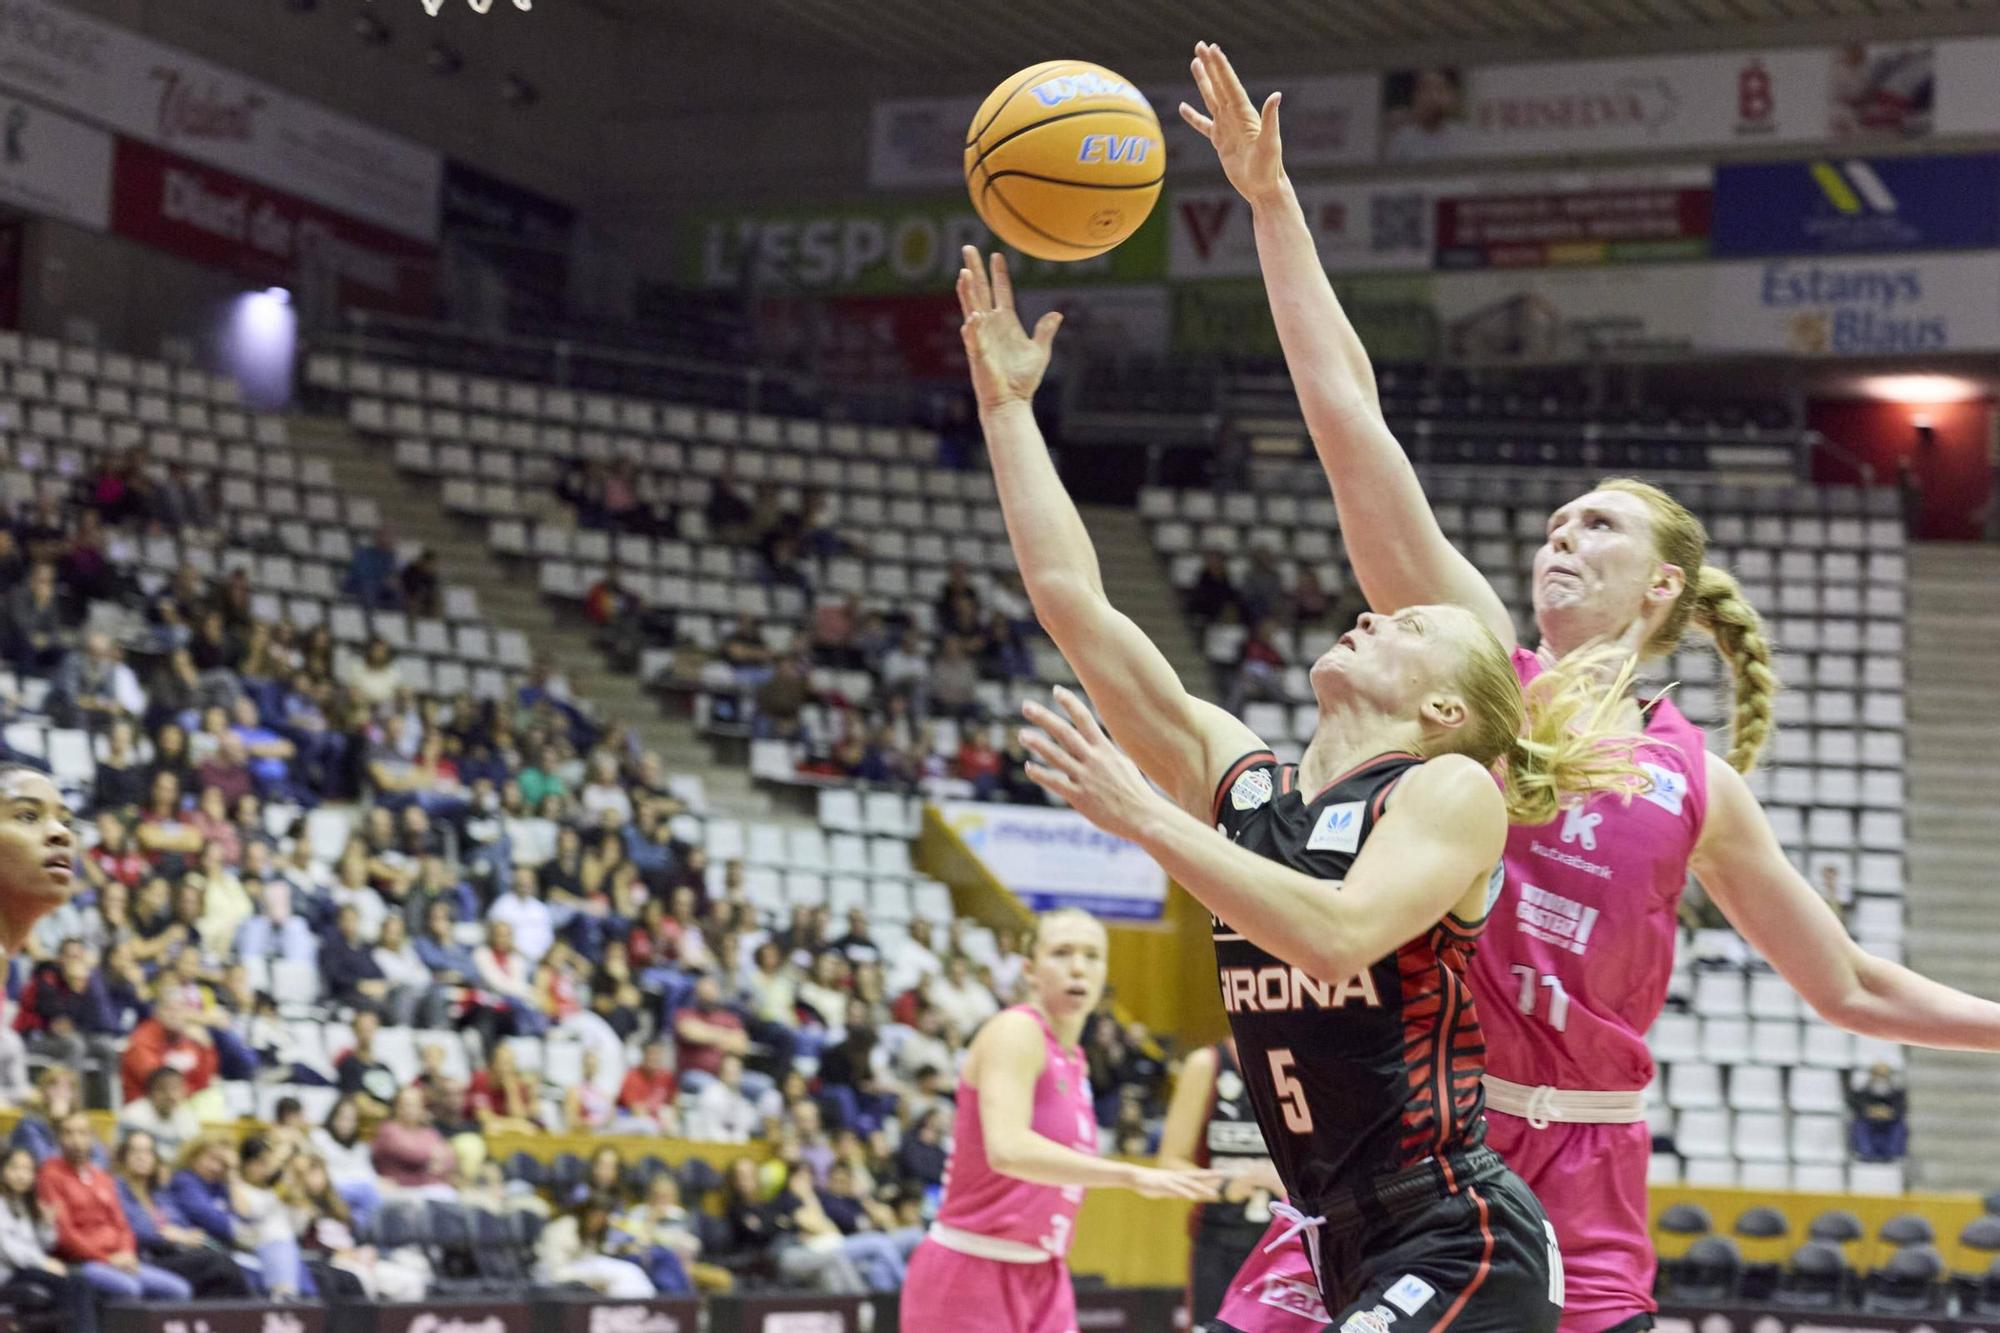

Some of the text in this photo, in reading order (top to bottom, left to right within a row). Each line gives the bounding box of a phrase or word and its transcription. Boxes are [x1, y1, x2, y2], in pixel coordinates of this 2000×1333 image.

[1761, 263, 1921, 307] Estanys
[1833, 309, 1948, 353] Blaus
[1510, 964, 1569, 1032] 11
[1265, 1048, 1313, 1133] 5
